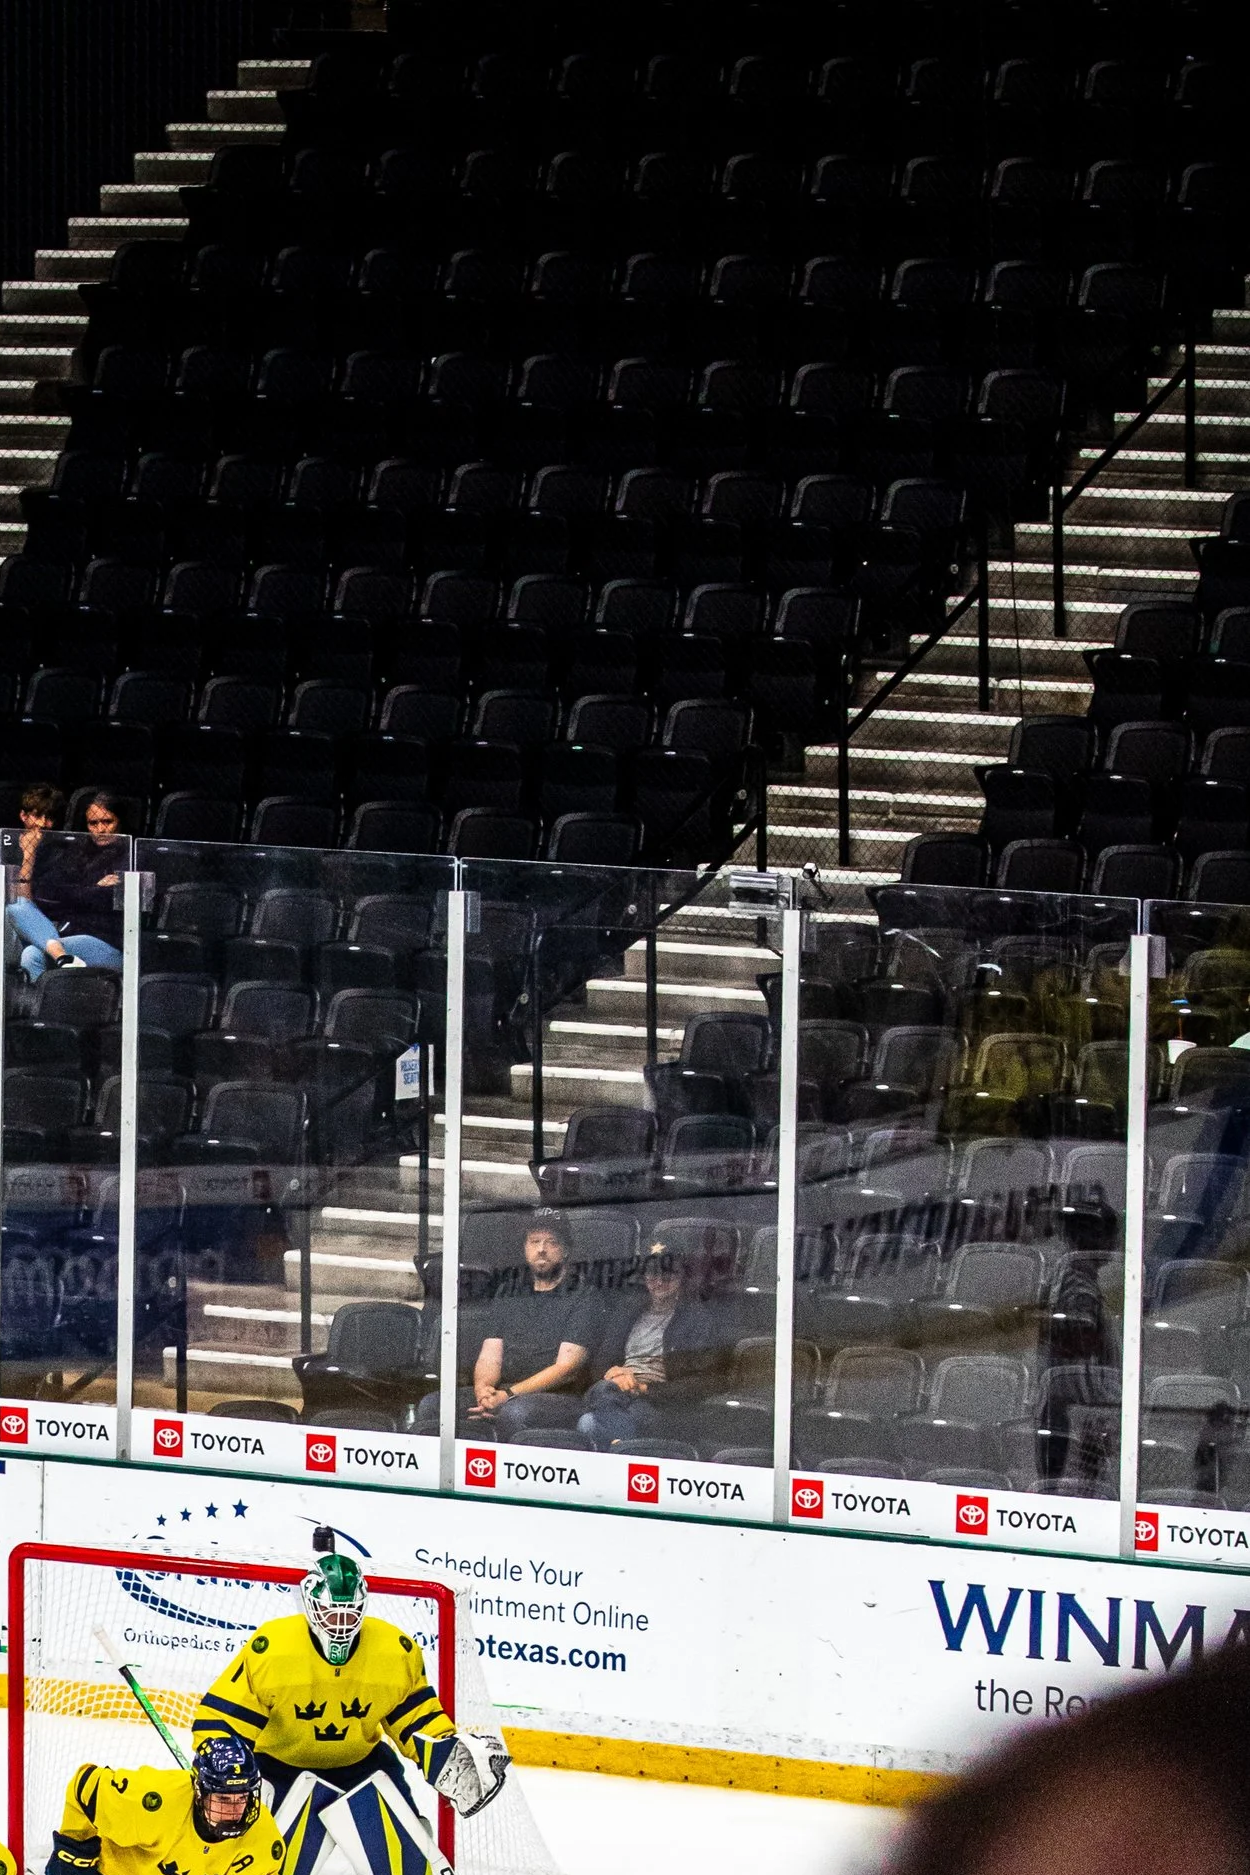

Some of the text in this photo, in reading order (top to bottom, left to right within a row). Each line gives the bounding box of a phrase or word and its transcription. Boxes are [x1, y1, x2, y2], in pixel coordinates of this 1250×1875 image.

[36, 1420, 109, 1440] TOYOTA
[191, 1433, 264, 1454] TOYOTA
[344, 1448, 418, 1469] TOYOTA
[504, 1463, 579, 1485] TOYOTA
[667, 1478, 744, 1500] TOYOTA
[832, 1493, 910, 1515] TOYOTA
[997, 1510, 1076, 1533] TOYOTA
[530, 1561, 583, 1586] Your
[574, 1602, 648, 1631] Online
[975, 1679, 1032, 1715] the
[234, 1765, 241, 1774] 3
[226, 1778, 249, 1786] CCM
